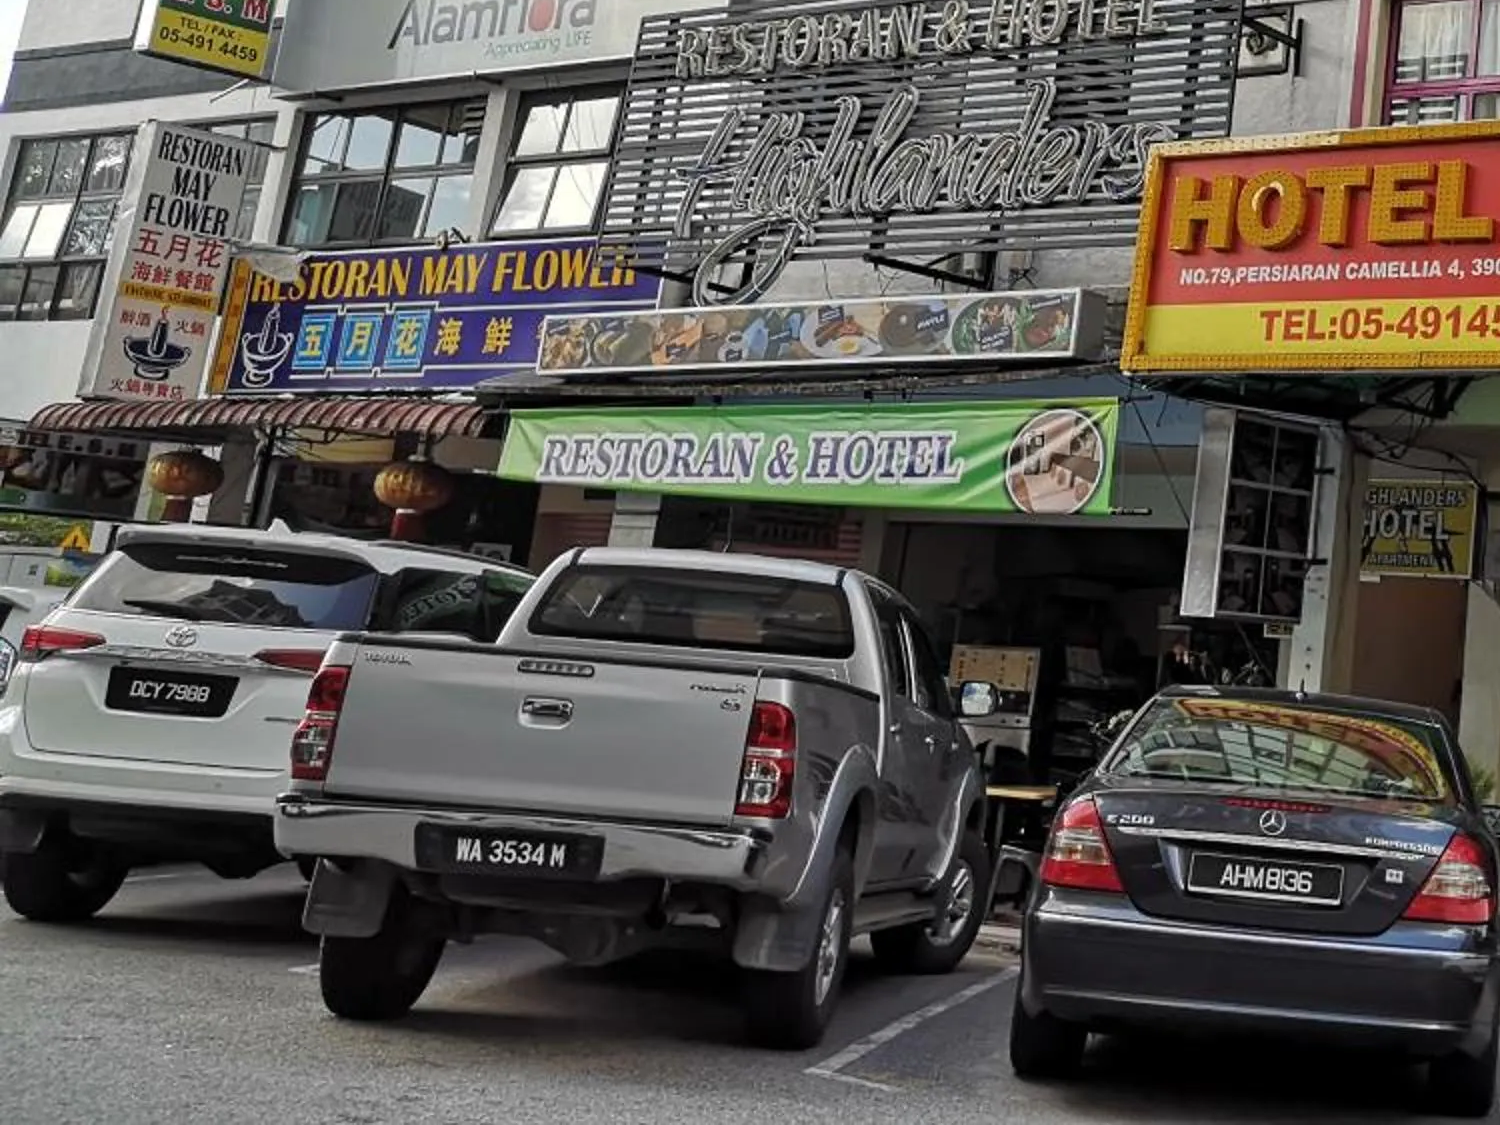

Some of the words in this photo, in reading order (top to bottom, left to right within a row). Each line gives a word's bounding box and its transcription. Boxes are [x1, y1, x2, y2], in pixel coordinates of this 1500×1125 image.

[159, 26, 214, 52] 05-491
[219, 41, 258, 62] 4459
[566, 29, 592, 48] LIFE
[674, 1, 927, 77] RESTORAN
[157, 129, 246, 178] RESTORAN
[170, 164, 218, 202] MAY
[143, 193, 230, 238] FLOWER
[1168, 159, 1494, 255] HOTEL
[132, 228, 226, 270] 五月花
[1345, 260, 1442, 281] CAMELLIA
[1447, 258, 1466, 281] 4,
[419, 250, 489, 297] MAY
[300, 314, 546, 358] 五月花海鮮
[538, 433, 761, 480] RESTORAN
[767, 438, 797, 480] &
[805, 432, 964, 479] HOTEL
[129, 679, 166, 700] DCY
[165, 682, 211, 704] 7988
[456, 837, 483, 863] WA
[488, 839, 546, 867] 3534
[549, 843, 566, 868] M
